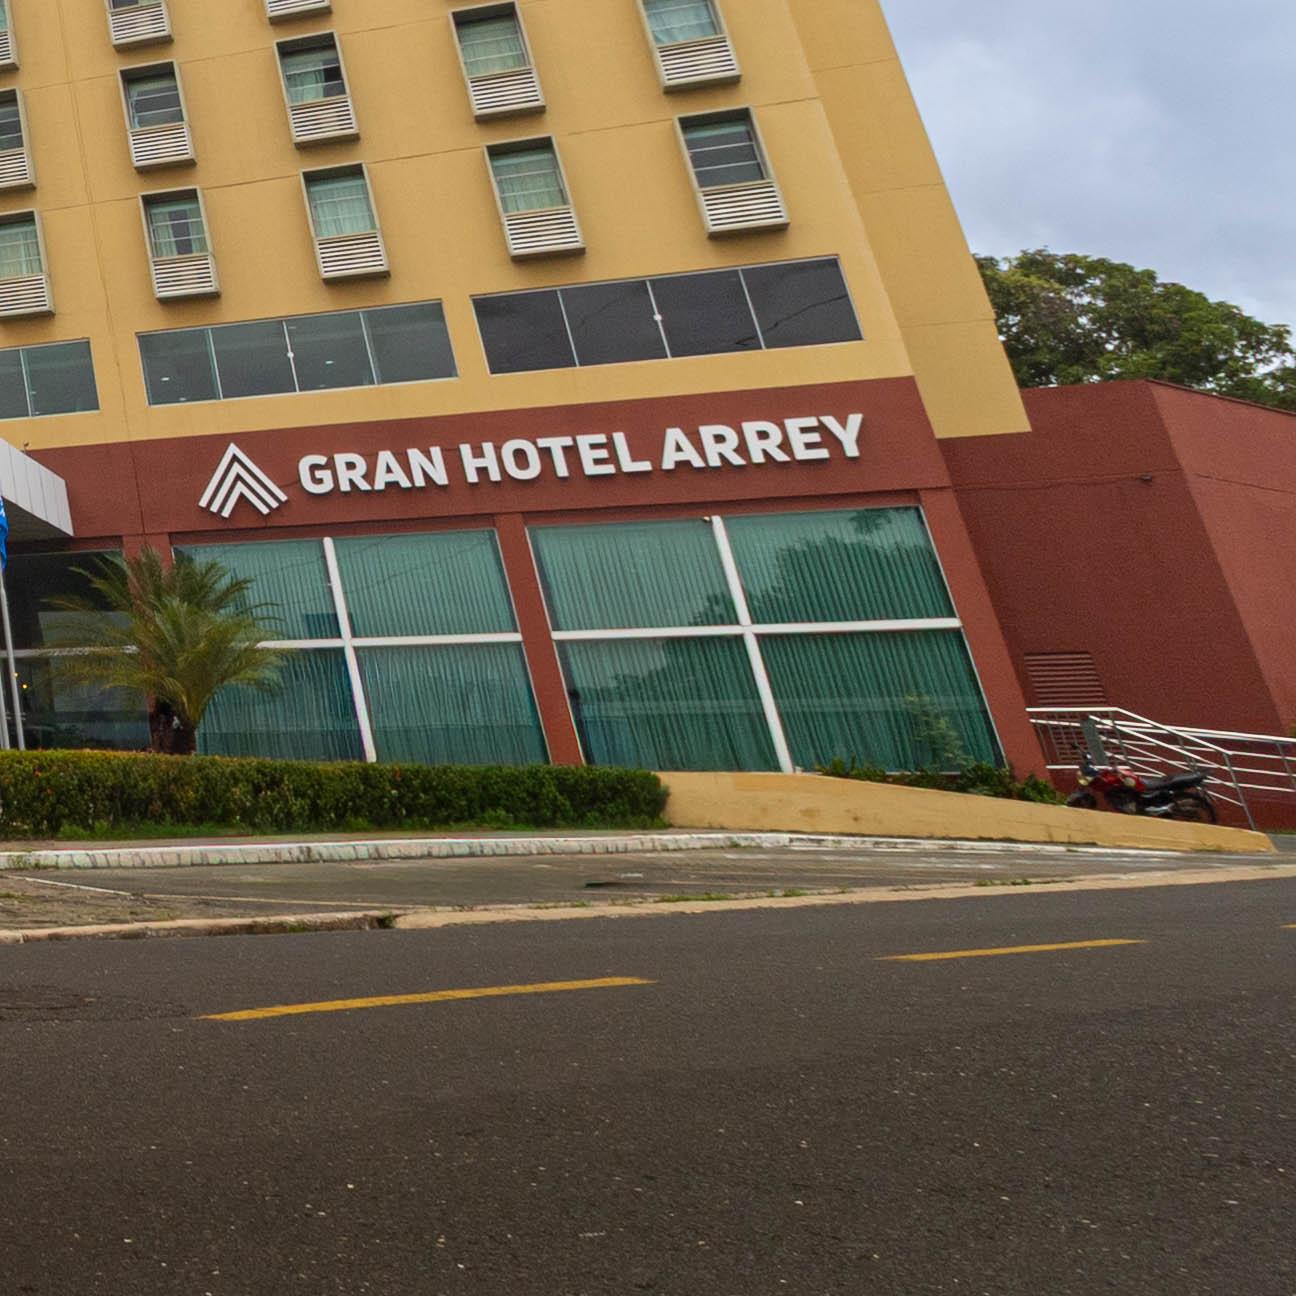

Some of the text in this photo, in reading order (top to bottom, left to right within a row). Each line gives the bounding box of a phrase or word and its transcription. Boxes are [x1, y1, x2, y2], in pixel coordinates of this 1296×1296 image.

[297, 412, 864, 495] GRAN HOTEL ARREY
